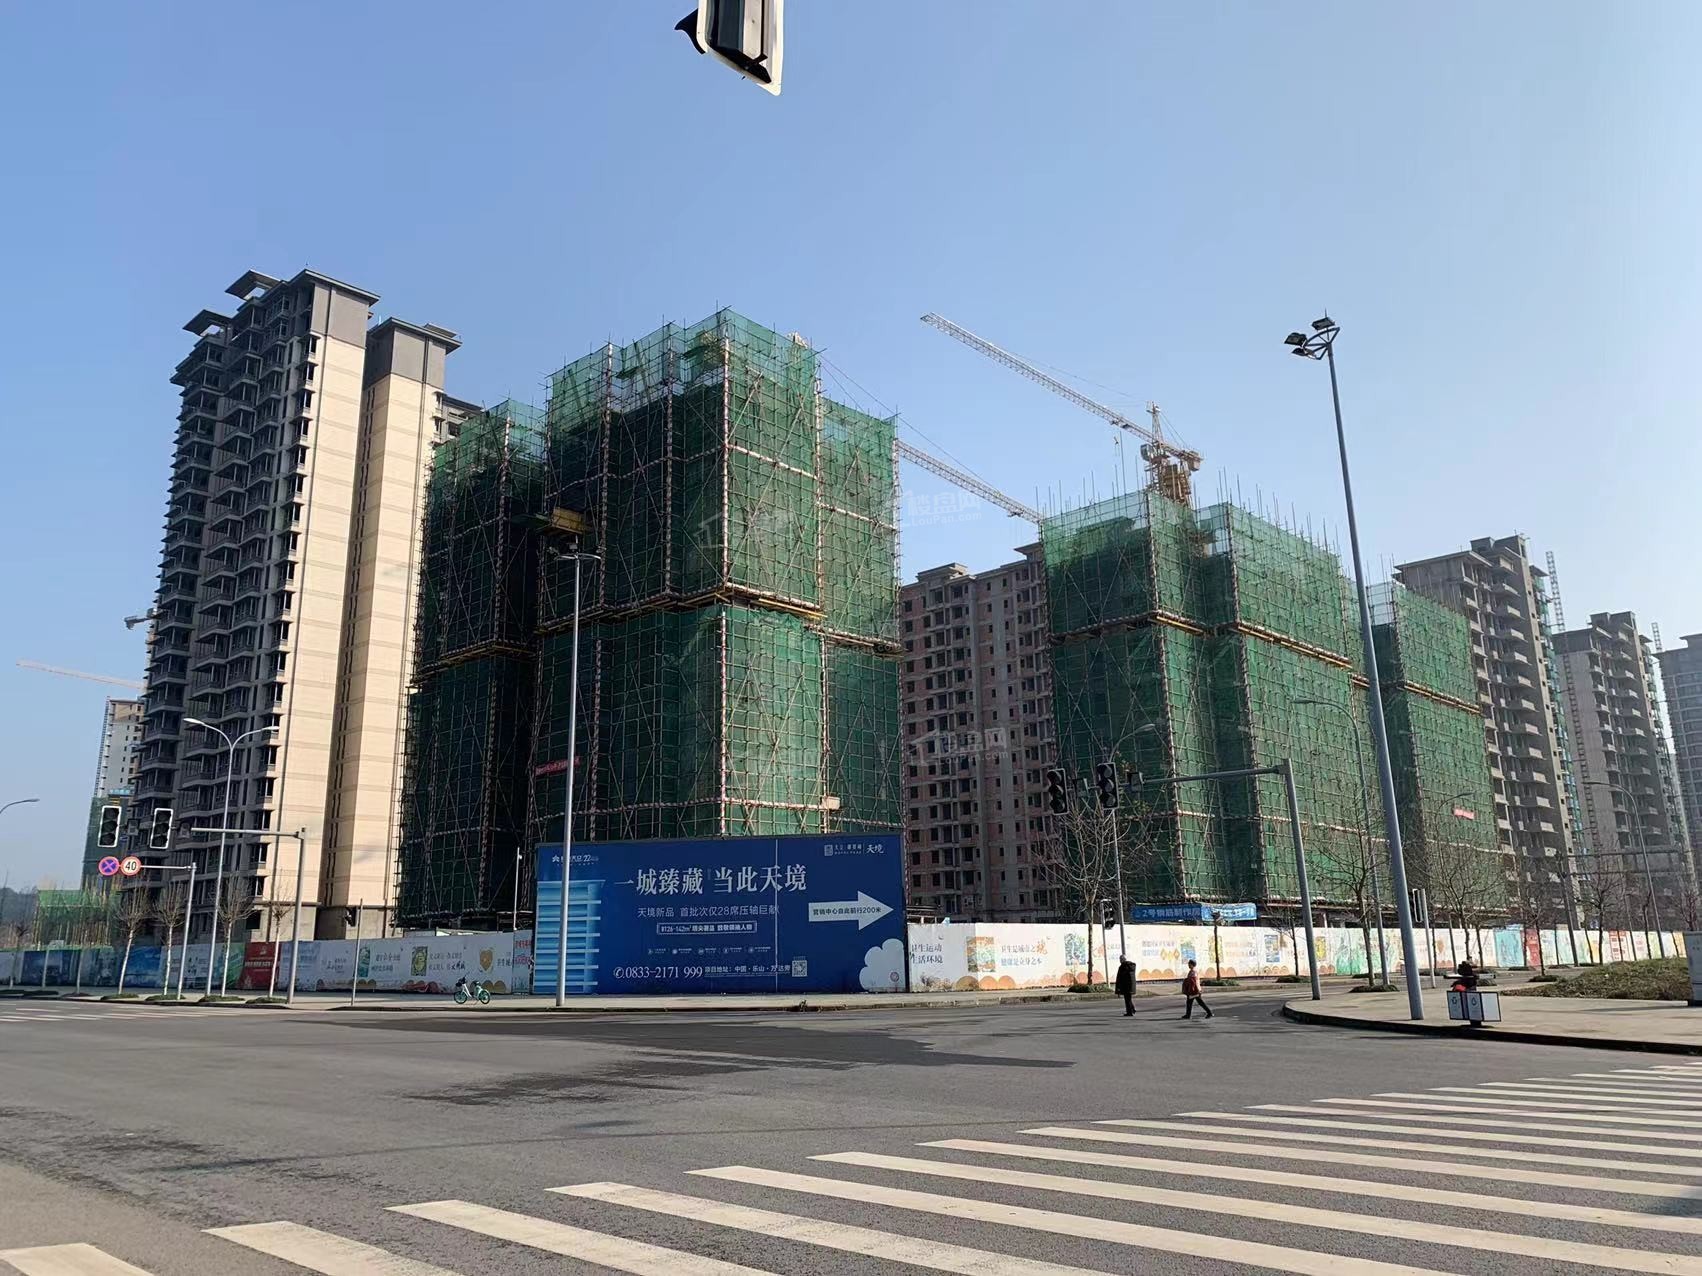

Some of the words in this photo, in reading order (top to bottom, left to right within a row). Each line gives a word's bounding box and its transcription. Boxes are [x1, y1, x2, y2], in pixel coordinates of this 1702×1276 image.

[125, 861, 137, 871] 40
[614, 867, 704, 896] 一城臻藏
[713, 863, 808, 894] 当此天境
[637, 906, 675, 918] 天境新品
[680, 904, 781, 917] 首批次仅28席压轴巨献
[625, 965, 680, 979] 0833-2171
[683, 965, 703, 979] 999
